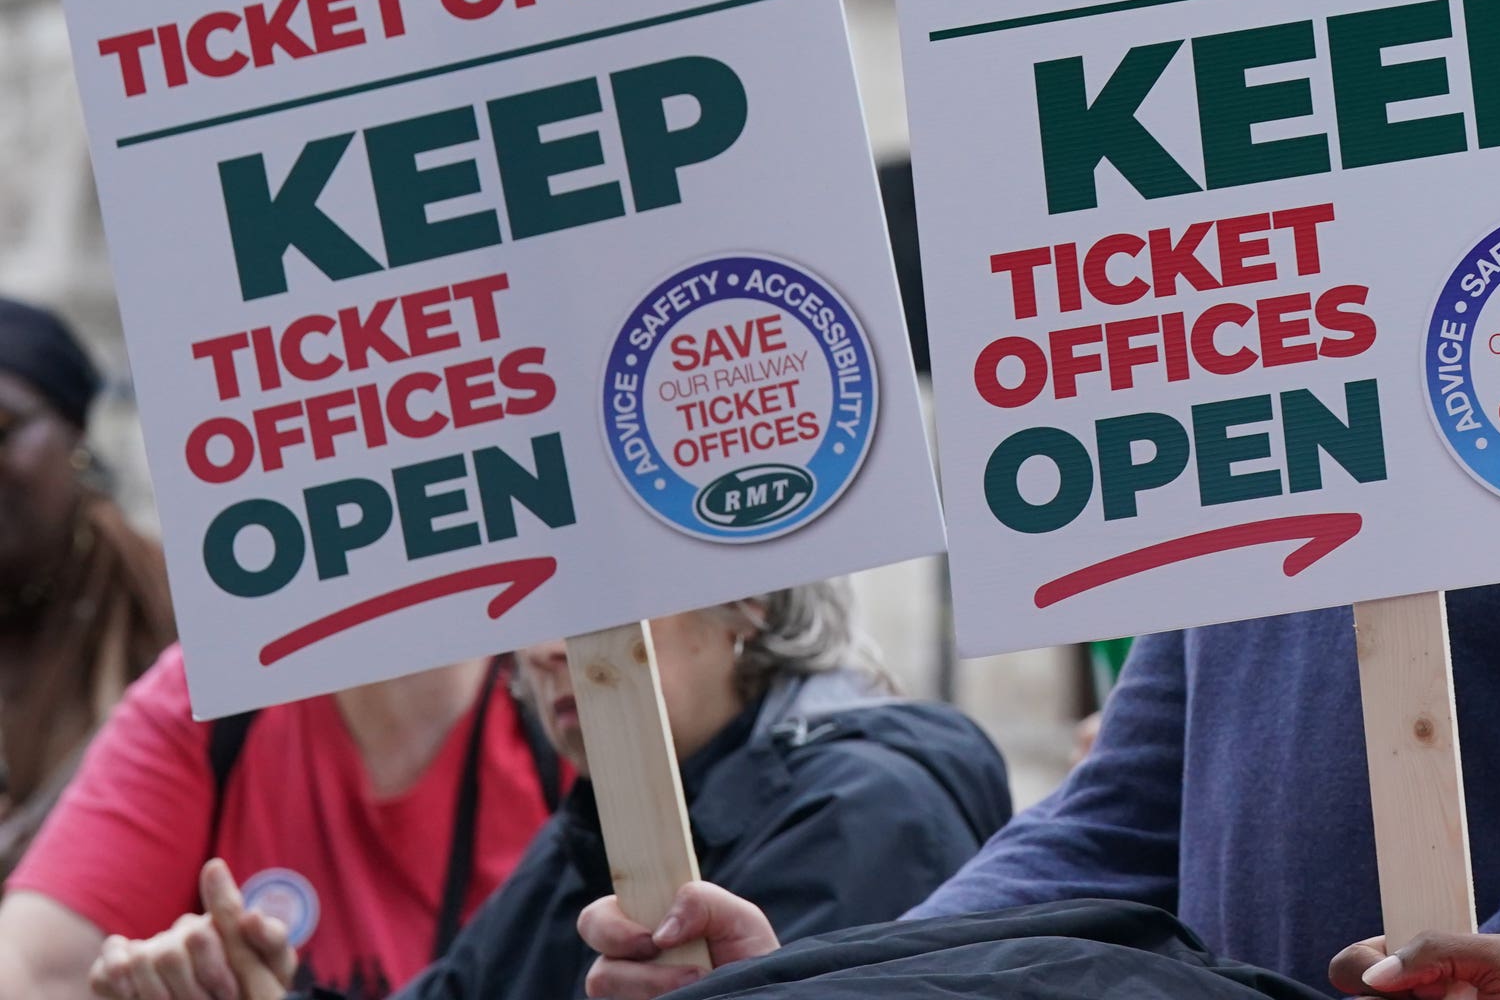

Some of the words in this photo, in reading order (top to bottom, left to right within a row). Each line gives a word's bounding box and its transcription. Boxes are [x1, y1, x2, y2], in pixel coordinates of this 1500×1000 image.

[219, 56, 747, 301] KEEP
[630, 271, 719, 350] SAFETY
[990, 203, 1334, 319] TICKET
[193, 274, 508, 400] TICKET
[659, 375, 709, 402] OUR
[714, 351, 808, 388] RAILWAY
[671, 314, 787, 371] SAVE
[745, 270, 862, 438] ACCESSIBILITY
[974, 285, 1376, 408] OFFICES
[1438, 319, 1482, 432] ADVICE
[186, 348, 556, 483] OFFICES
[614, 372, 659, 476] ADVICE
[673, 412, 820, 467] OFFICES
[676, 380, 799, 431] TICKET
[985, 379, 1387, 533] OPEN
[205, 432, 576, 597] OPEN
[725, 480, 789, 512] RMT
